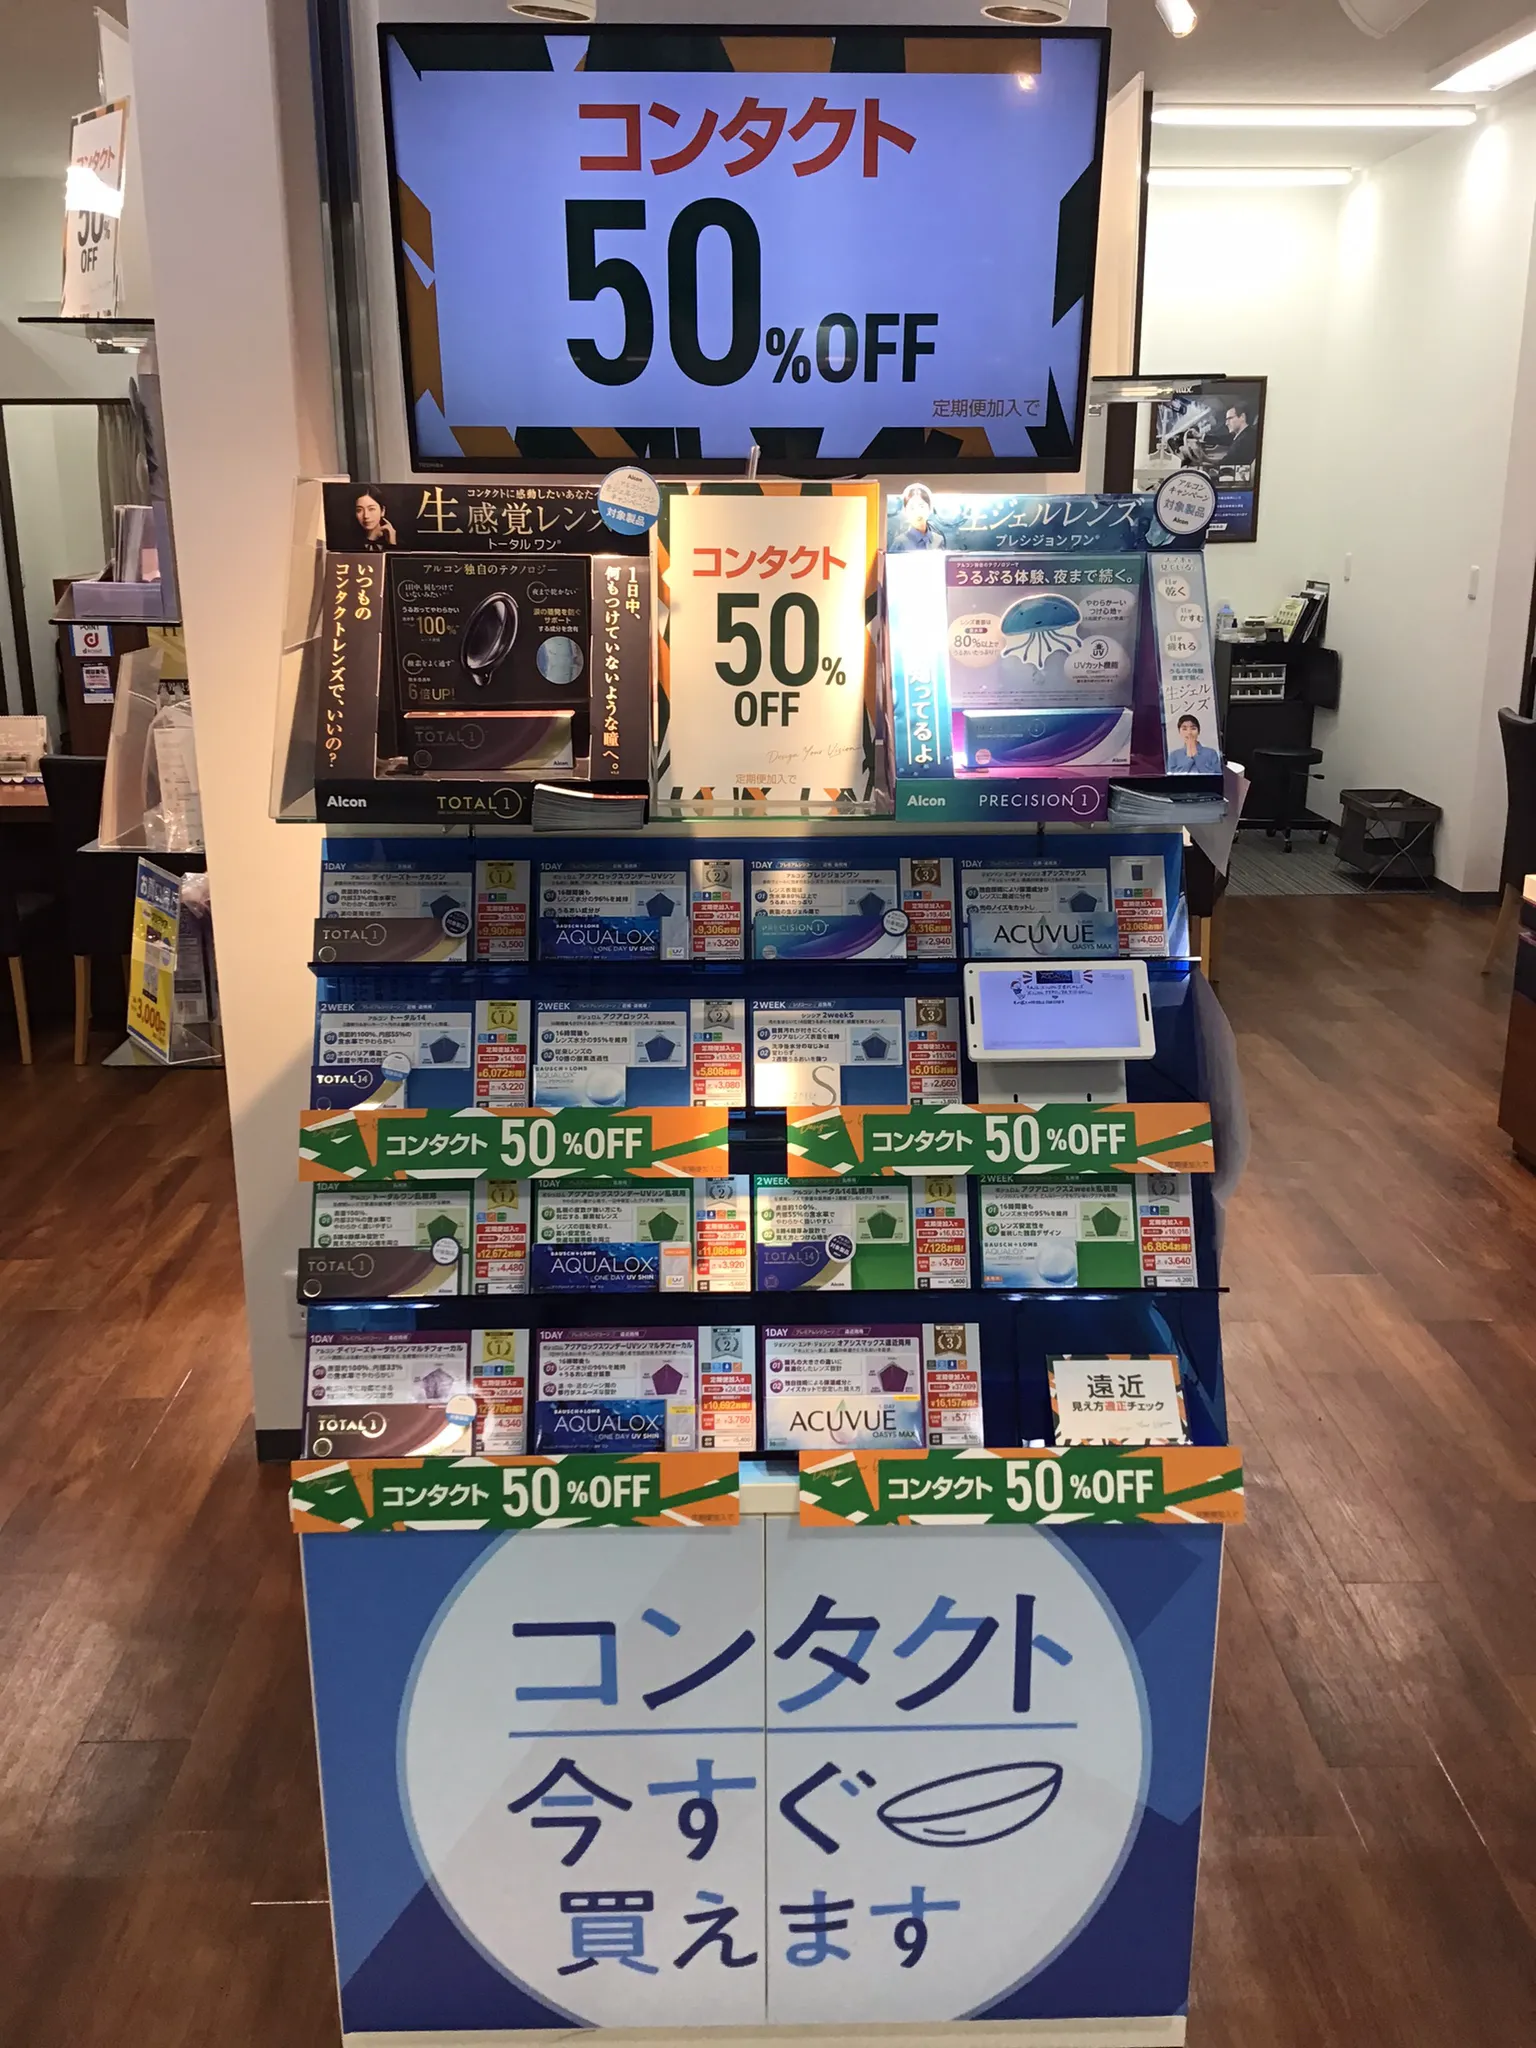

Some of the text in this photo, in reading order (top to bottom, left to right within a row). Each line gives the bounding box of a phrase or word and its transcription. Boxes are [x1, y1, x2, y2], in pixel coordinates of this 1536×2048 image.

[578, 96, 917, 178] コンタクト
[81, 247, 99, 273] OFF
[931, 398, 1040, 419] 定期便加入で
[1177, 479, 1205, 492] アルコン
[1169, 486, 1209, 502] キャンペーン
[1163, 498, 1205, 518] 対象製品
[606, 506, 645, 527] 対象製品
[1173, 517, 1188, 525] Alcon
[693, 545, 846, 580] コンタクト
[423, 564, 558, 576] アルコン独自のテクノロジー
[955, 568, 1133, 585] うるぷる体験、夜まで続く。
[355, 564, 373, 620] いつもの
[1165, 586, 1187, 597] 乾く
[1086, 599, 1127, 607] やわらかーい
[402, 606, 460, 614] うるおってやわらかい
[1180, 614, 1204, 623] かすむ
[715, 592, 846, 687] 50%
[1167, 642, 1196, 651] 疲れる
[1074, 661, 1118, 669] UVカット機能
[1165, 684, 1210, 700] 生ジェル
[734, 691, 799, 727] OFF
[1169, 697, 1209, 714] レンズ
[767, 743, 862, 764] Design Your Vision
[735, 773, 796, 785] 定期便加入で
[326, 796, 367, 808] Alcon
[908, 795, 945, 807] Alcon
[979, 794, 1073, 807] PRECISION
[556, 929, 656, 945] AQUALOX
[993, 925, 1094, 944] ACUVUE
[1137, 936, 1163, 944] ¥4,620
[713, 939, 740, 948] ¥3,290
[320, 1003, 355, 1011] 2WEEK
[537, 1002, 570, 1010] 2WEEK
[716, 1013, 722, 1022] 2
[928, 1010, 935, 1021] 3
[811, 1065, 837, 1106] S
[386, 1133, 488, 1156] コンタクト
[872, 1129, 973, 1152] コンタクト
[756, 1177, 790, 1185] 2WEEK
[980, 1175, 1014, 1183] 2WEEK
[718, 1189, 725, 1199] 2
[764, 1252, 801, 1261] TOTAL
[939, 1258, 965, 1267] ¥3,780
[1164, 1256, 1191, 1265] ¥3,640
[551, 1257, 655, 1274] AQUALOX
[718, 1261, 745, 1269] ¥3,920
[310, 1335, 334, 1343] 1DAY
[540, 1331, 563, 1339] 1DAY
[765, 1329, 788, 1337] 1DAY
[724, 1341, 731, 1351] 2
[837, 1339, 911, 1347] オアシスマックス遠近両用
[946, 1337, 954, 1348] 3
[1086, 1374, 1146, 1399] 遠近
[1072, 1401, 1164, 1412] 見え方適正チェック
[554, 1415, 660, 1433] AQUALOX
[723, 1415, 750, 1424] ¥3,780
[789, 1410, 896, 1431] ACUVUE
[887, 1475, 993, 1500] コンタクト
[382, 1481, 489, 1507] コンタクト
[511, 1593, 1074, 1715] コンタクト
[508, 1757, 876, 1868] 今すぐ
[556, 1885, 962, 1977] 買えます
